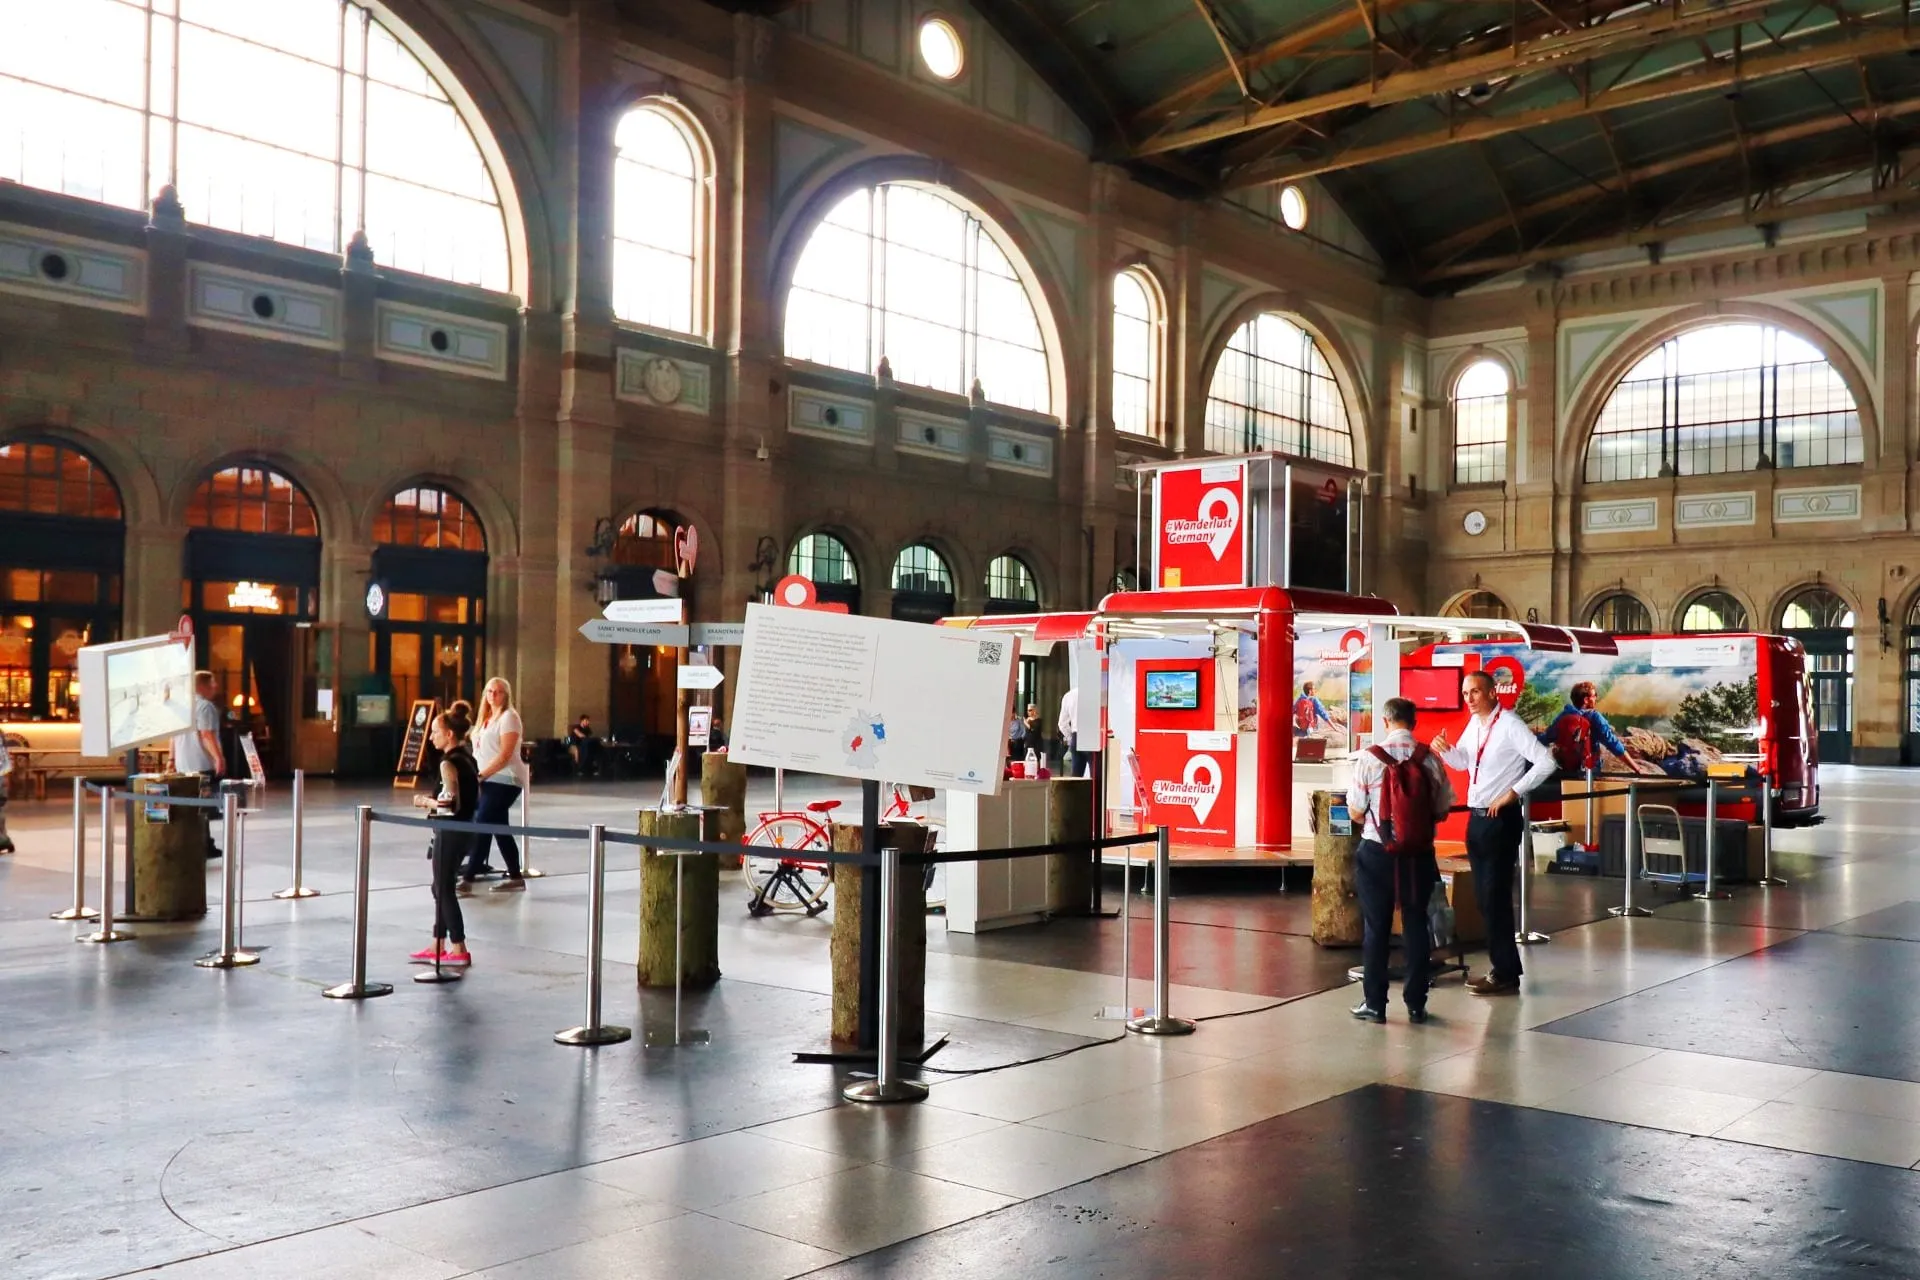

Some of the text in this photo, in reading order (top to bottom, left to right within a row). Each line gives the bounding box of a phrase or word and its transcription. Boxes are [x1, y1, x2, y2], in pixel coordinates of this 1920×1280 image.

[1167, 517, 1232, 530] #Wanderlust
[1169, 532, 1215, 544] Germany
[1154, 782, 1215, 794] #Wanderlust
[1156, 793, 1200, 807] Germany
